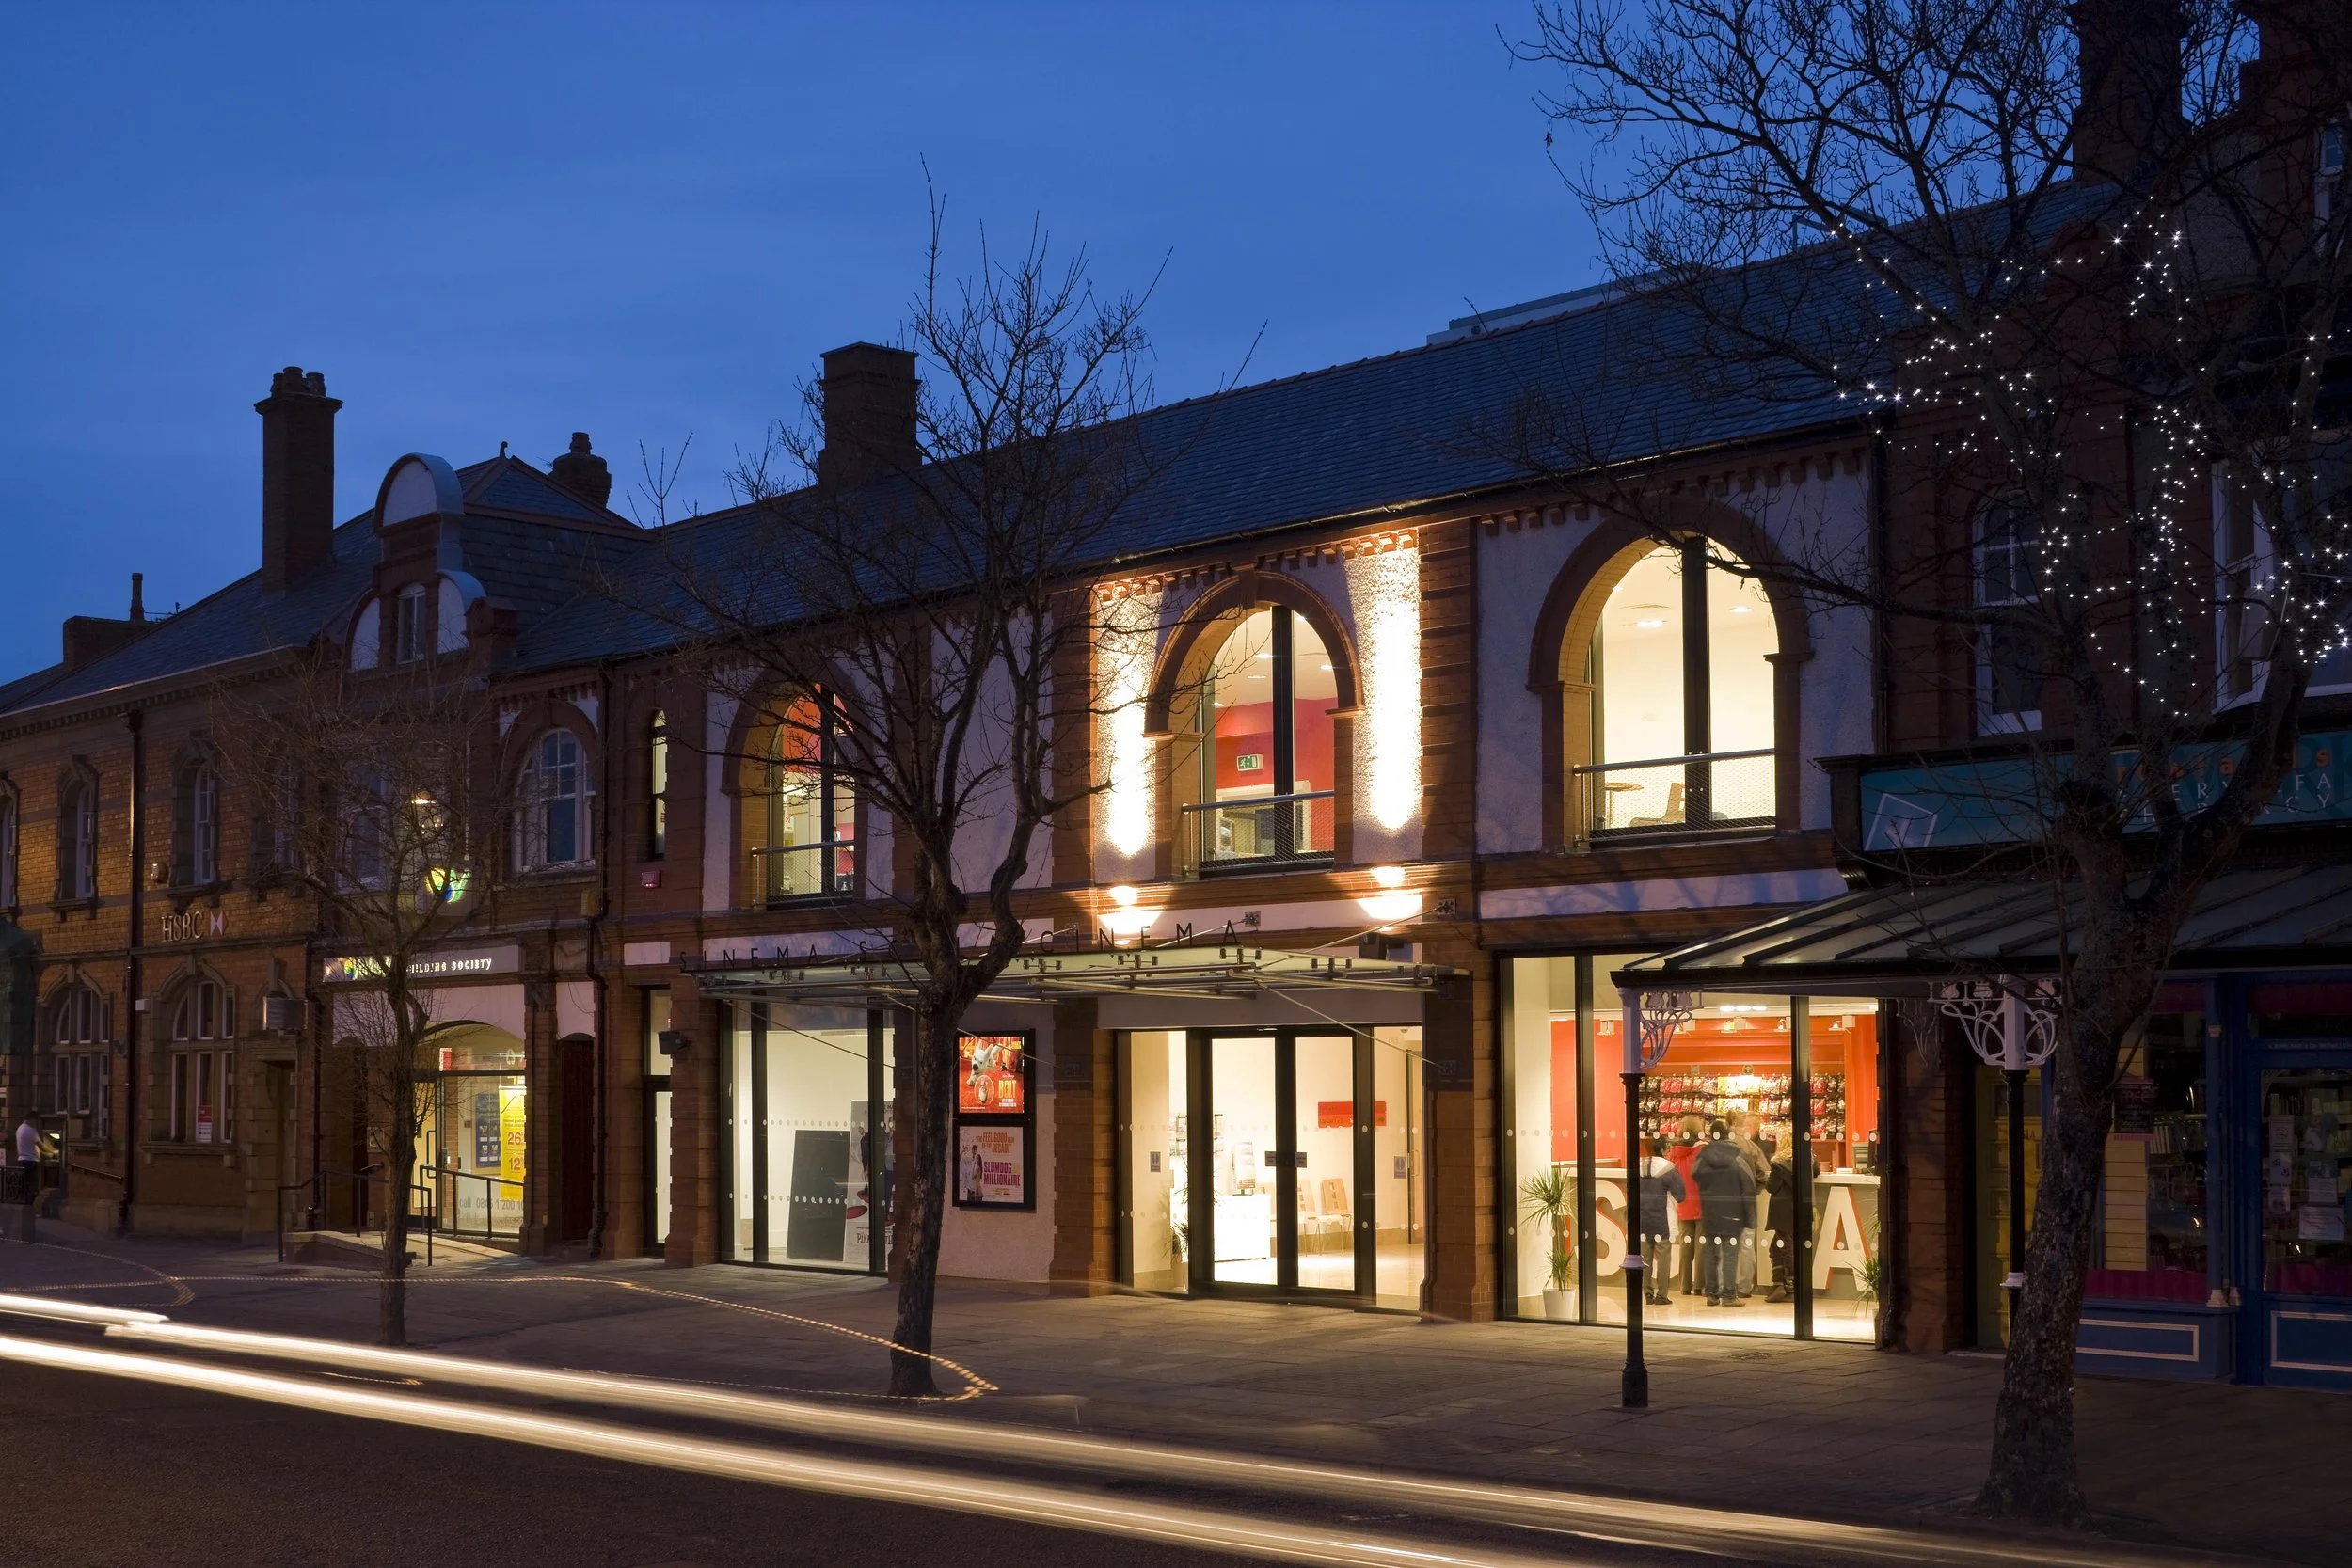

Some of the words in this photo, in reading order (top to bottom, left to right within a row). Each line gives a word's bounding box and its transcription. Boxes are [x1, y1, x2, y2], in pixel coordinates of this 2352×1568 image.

[161, 911, 203, 942] HSBC
[679, 944, 819, 972] SINEMA
[1040, 919, 1241, 954] CINEMA
[451, 958, 492, 971] SOCIETY
[998, 1080, 1017, 1098] BOLT
[983, 1161, 1012, 1174] SLUMDOG
[983, 1173, 1021, 1186] MILLIONAIRE
